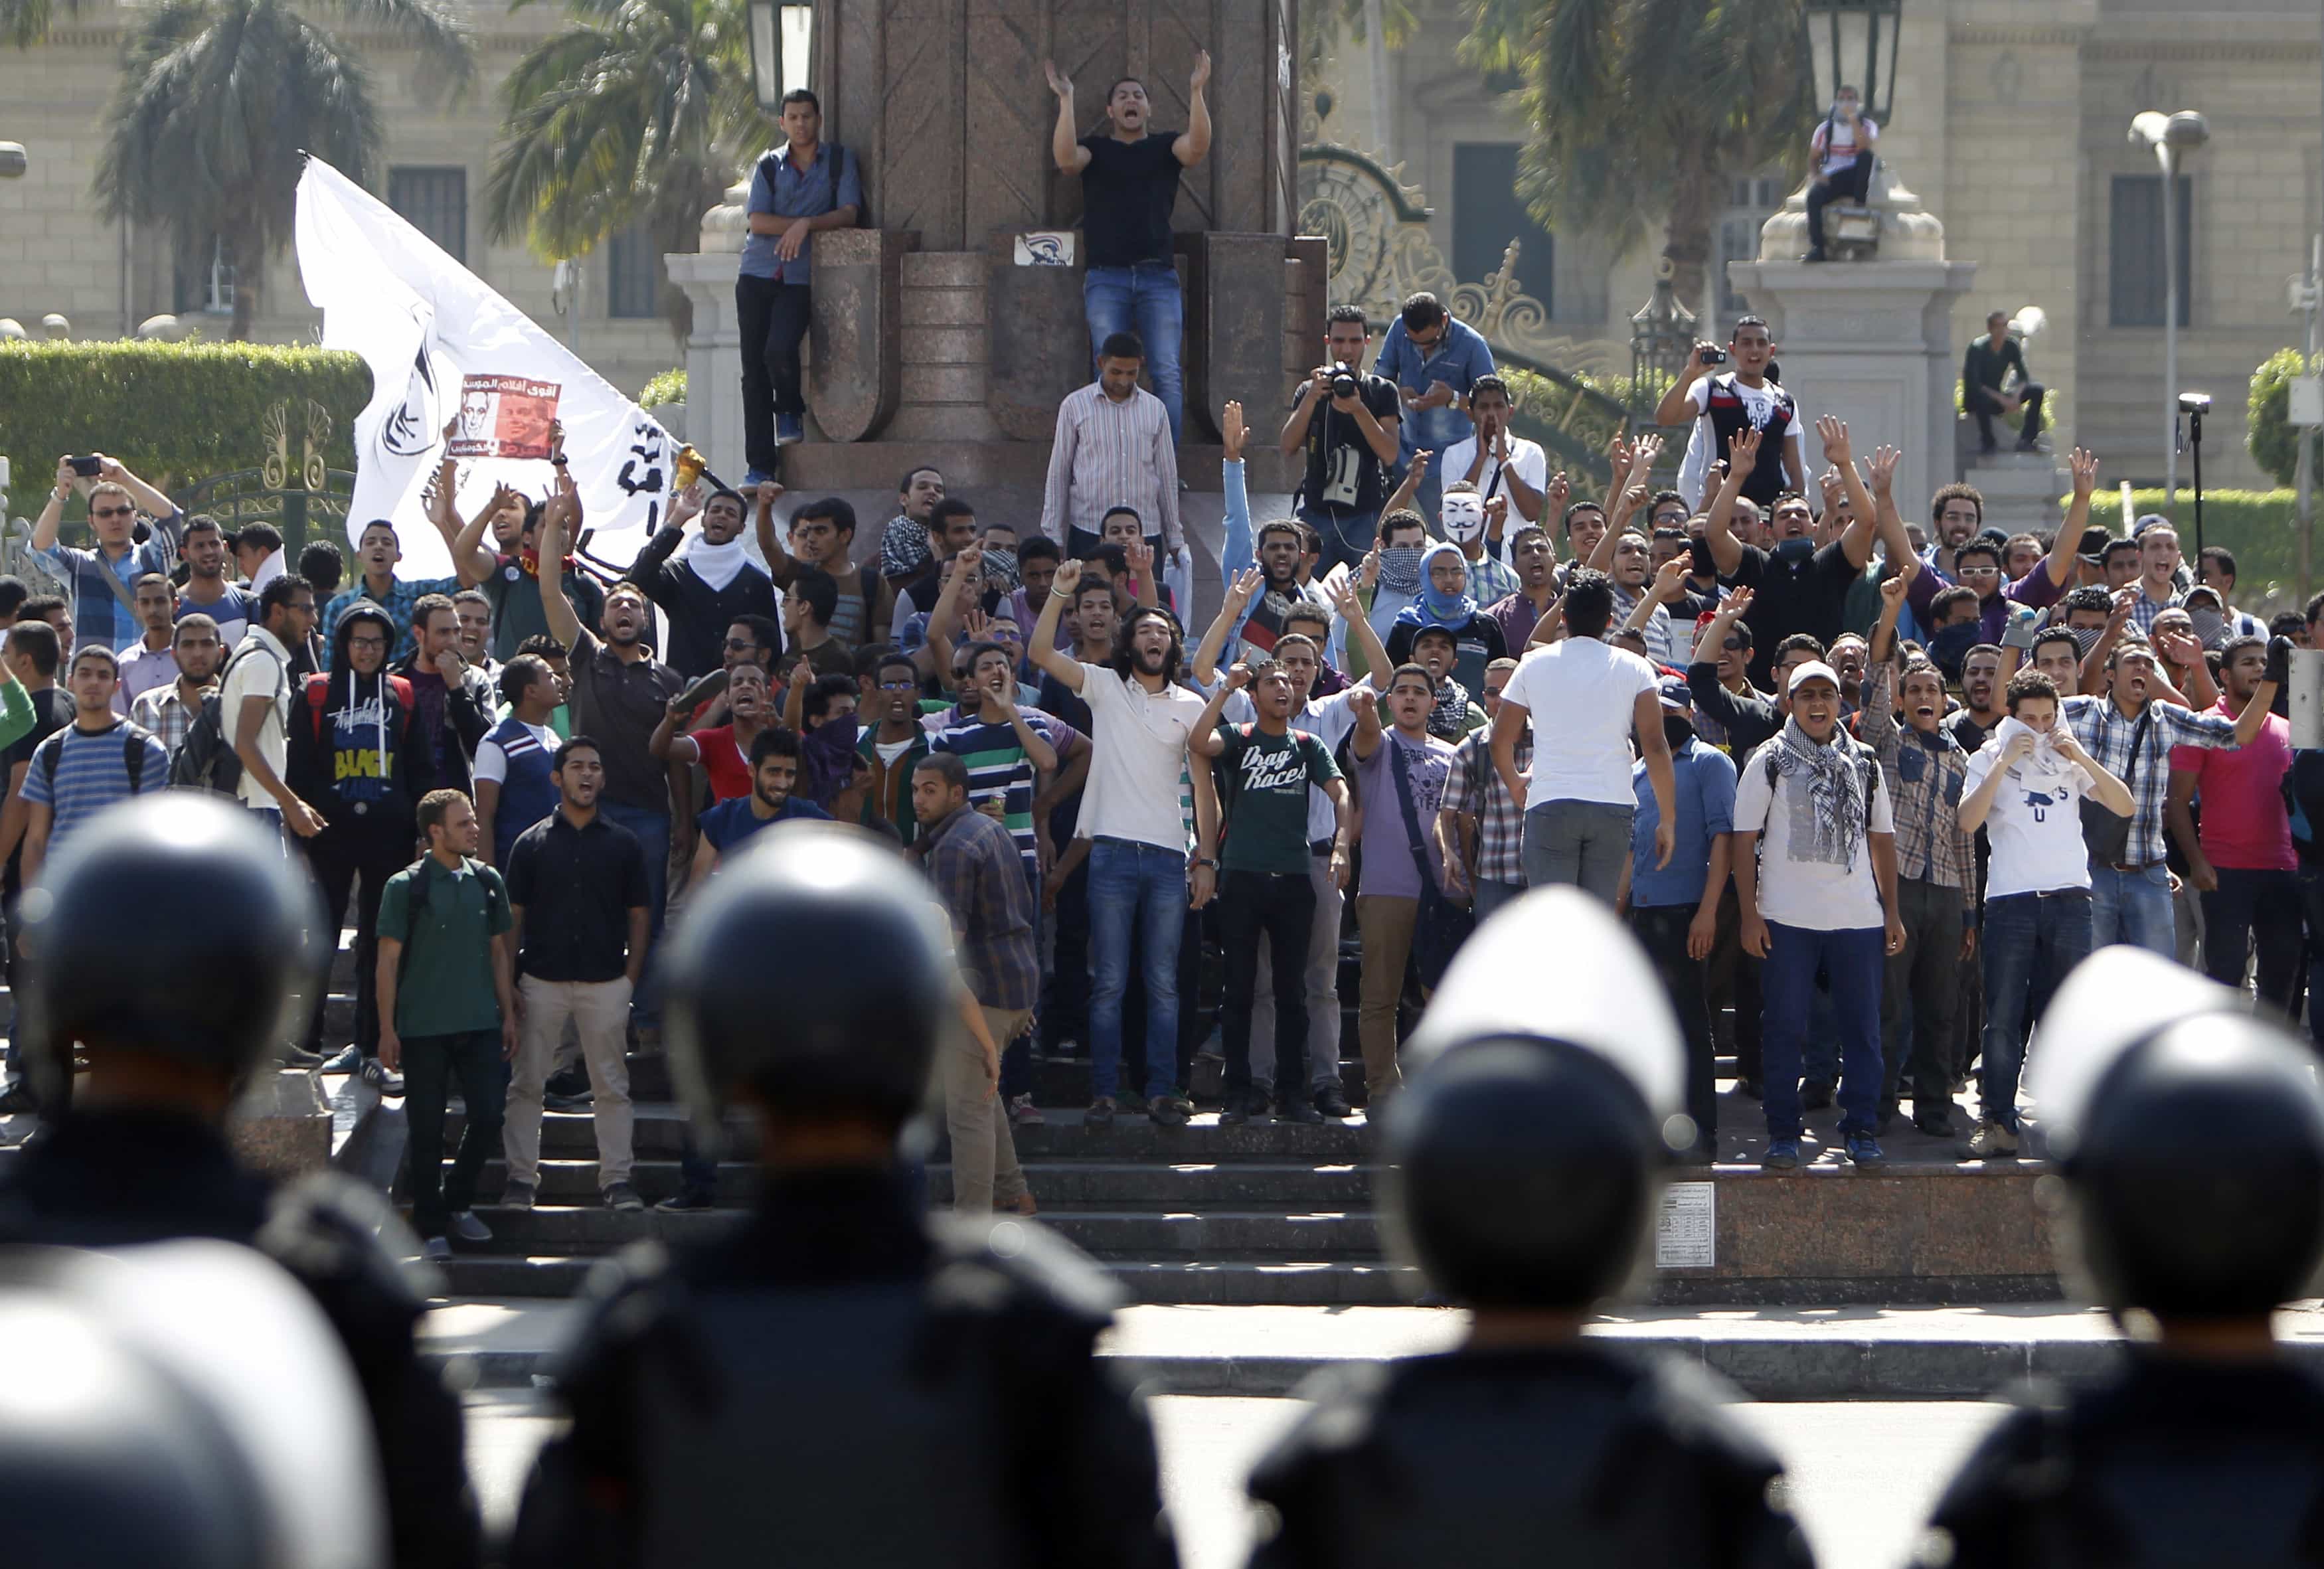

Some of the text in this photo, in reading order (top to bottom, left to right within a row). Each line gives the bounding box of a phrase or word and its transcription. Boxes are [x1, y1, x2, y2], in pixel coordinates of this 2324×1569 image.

[498, 379, 527, 393] أفلام
[527, 384, 557, 398] أقوى
[1240, 745, 1293, 771] Drag
[1244, 761, 1307, 791] Races
